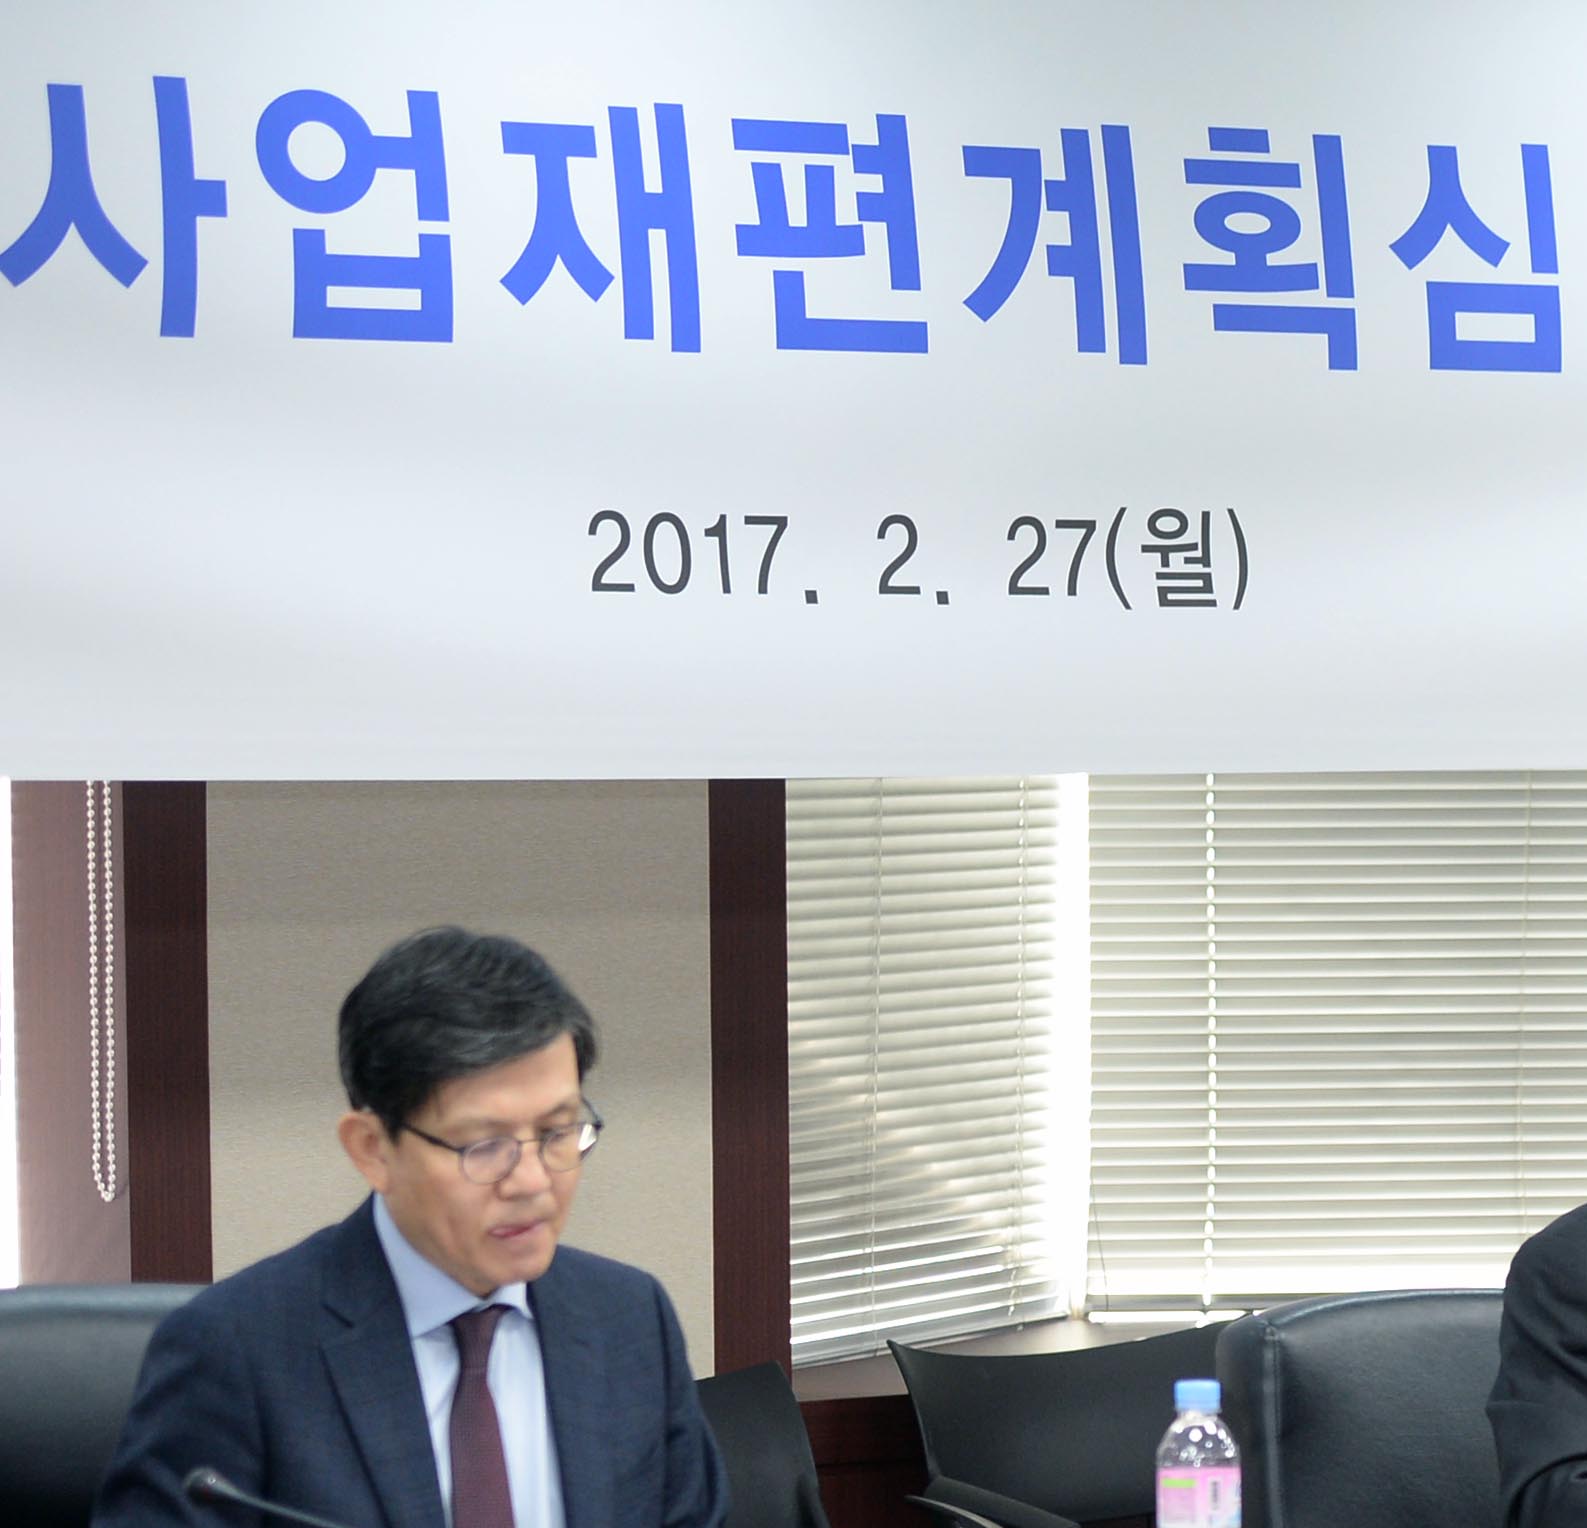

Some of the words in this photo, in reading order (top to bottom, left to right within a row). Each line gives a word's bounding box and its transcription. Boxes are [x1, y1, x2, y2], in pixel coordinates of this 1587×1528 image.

[588, 510, 818, 604] 2017.
[877, 514, 949, 604] 2.
[1006, 508, 1249, 609] 27(월)
